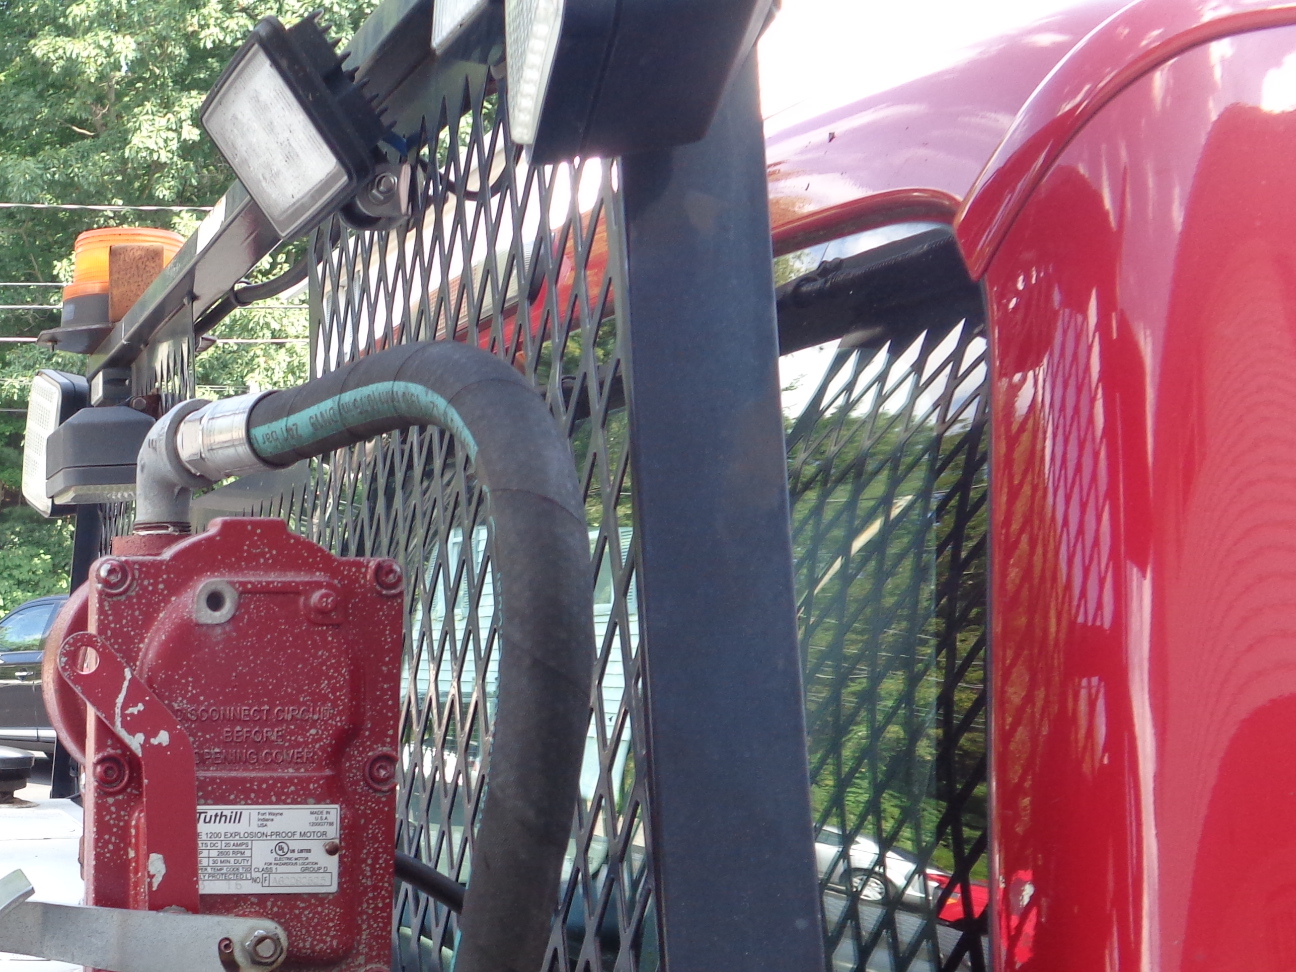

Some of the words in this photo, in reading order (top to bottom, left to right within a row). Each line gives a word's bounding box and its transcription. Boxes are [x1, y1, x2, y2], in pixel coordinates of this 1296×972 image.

[274, 706, 334, 721] CIRCUIT
[223, 727, 284, 742] BEFORE
[262, 748, 314, 764] COVER
[197, 811, 243, 825] Tuthill
[224, 831, 297, 839] EXPLOSION-PROOF
